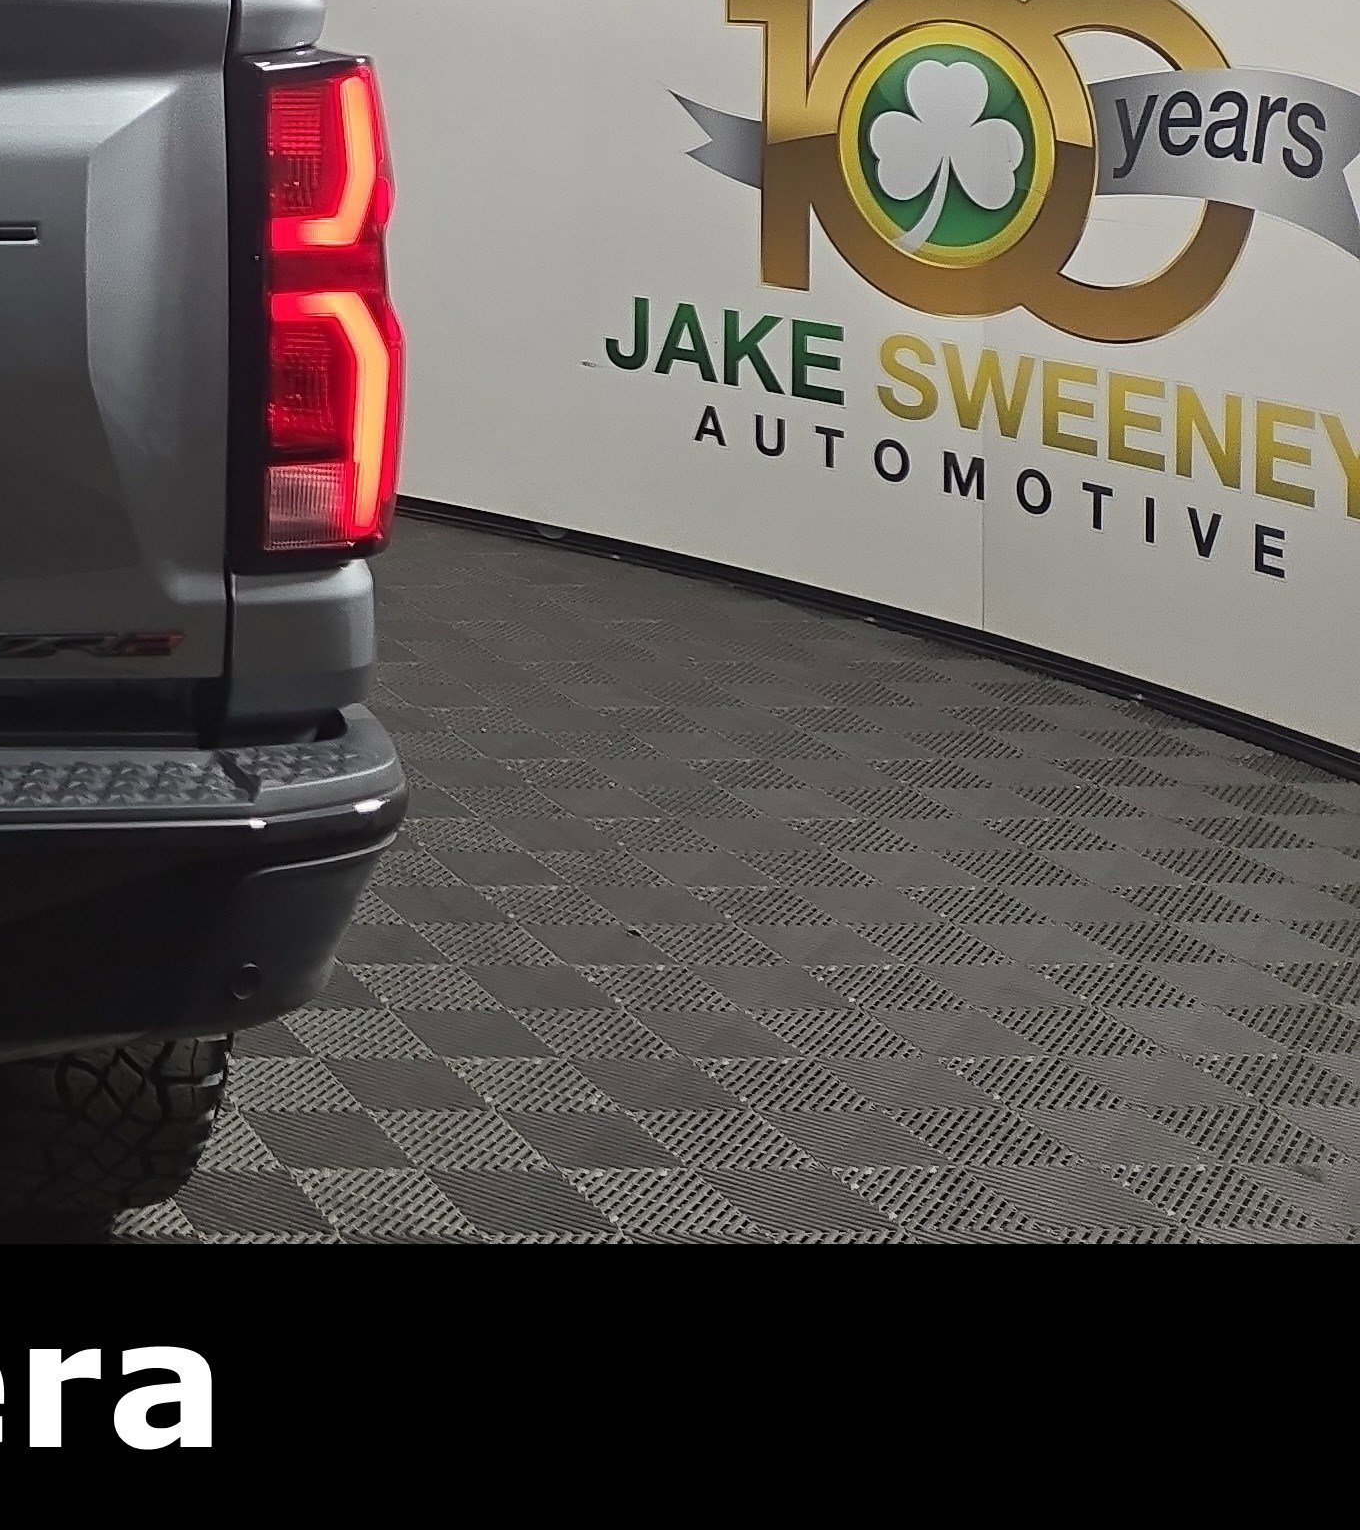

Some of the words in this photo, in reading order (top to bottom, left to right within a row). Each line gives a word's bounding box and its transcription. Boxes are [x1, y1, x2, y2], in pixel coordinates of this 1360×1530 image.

[1112, 87, 1327, 181] years
[605, 296, 846, 407] JAKE
[694, 405, 1286, 579] AUTOMOTIVE
